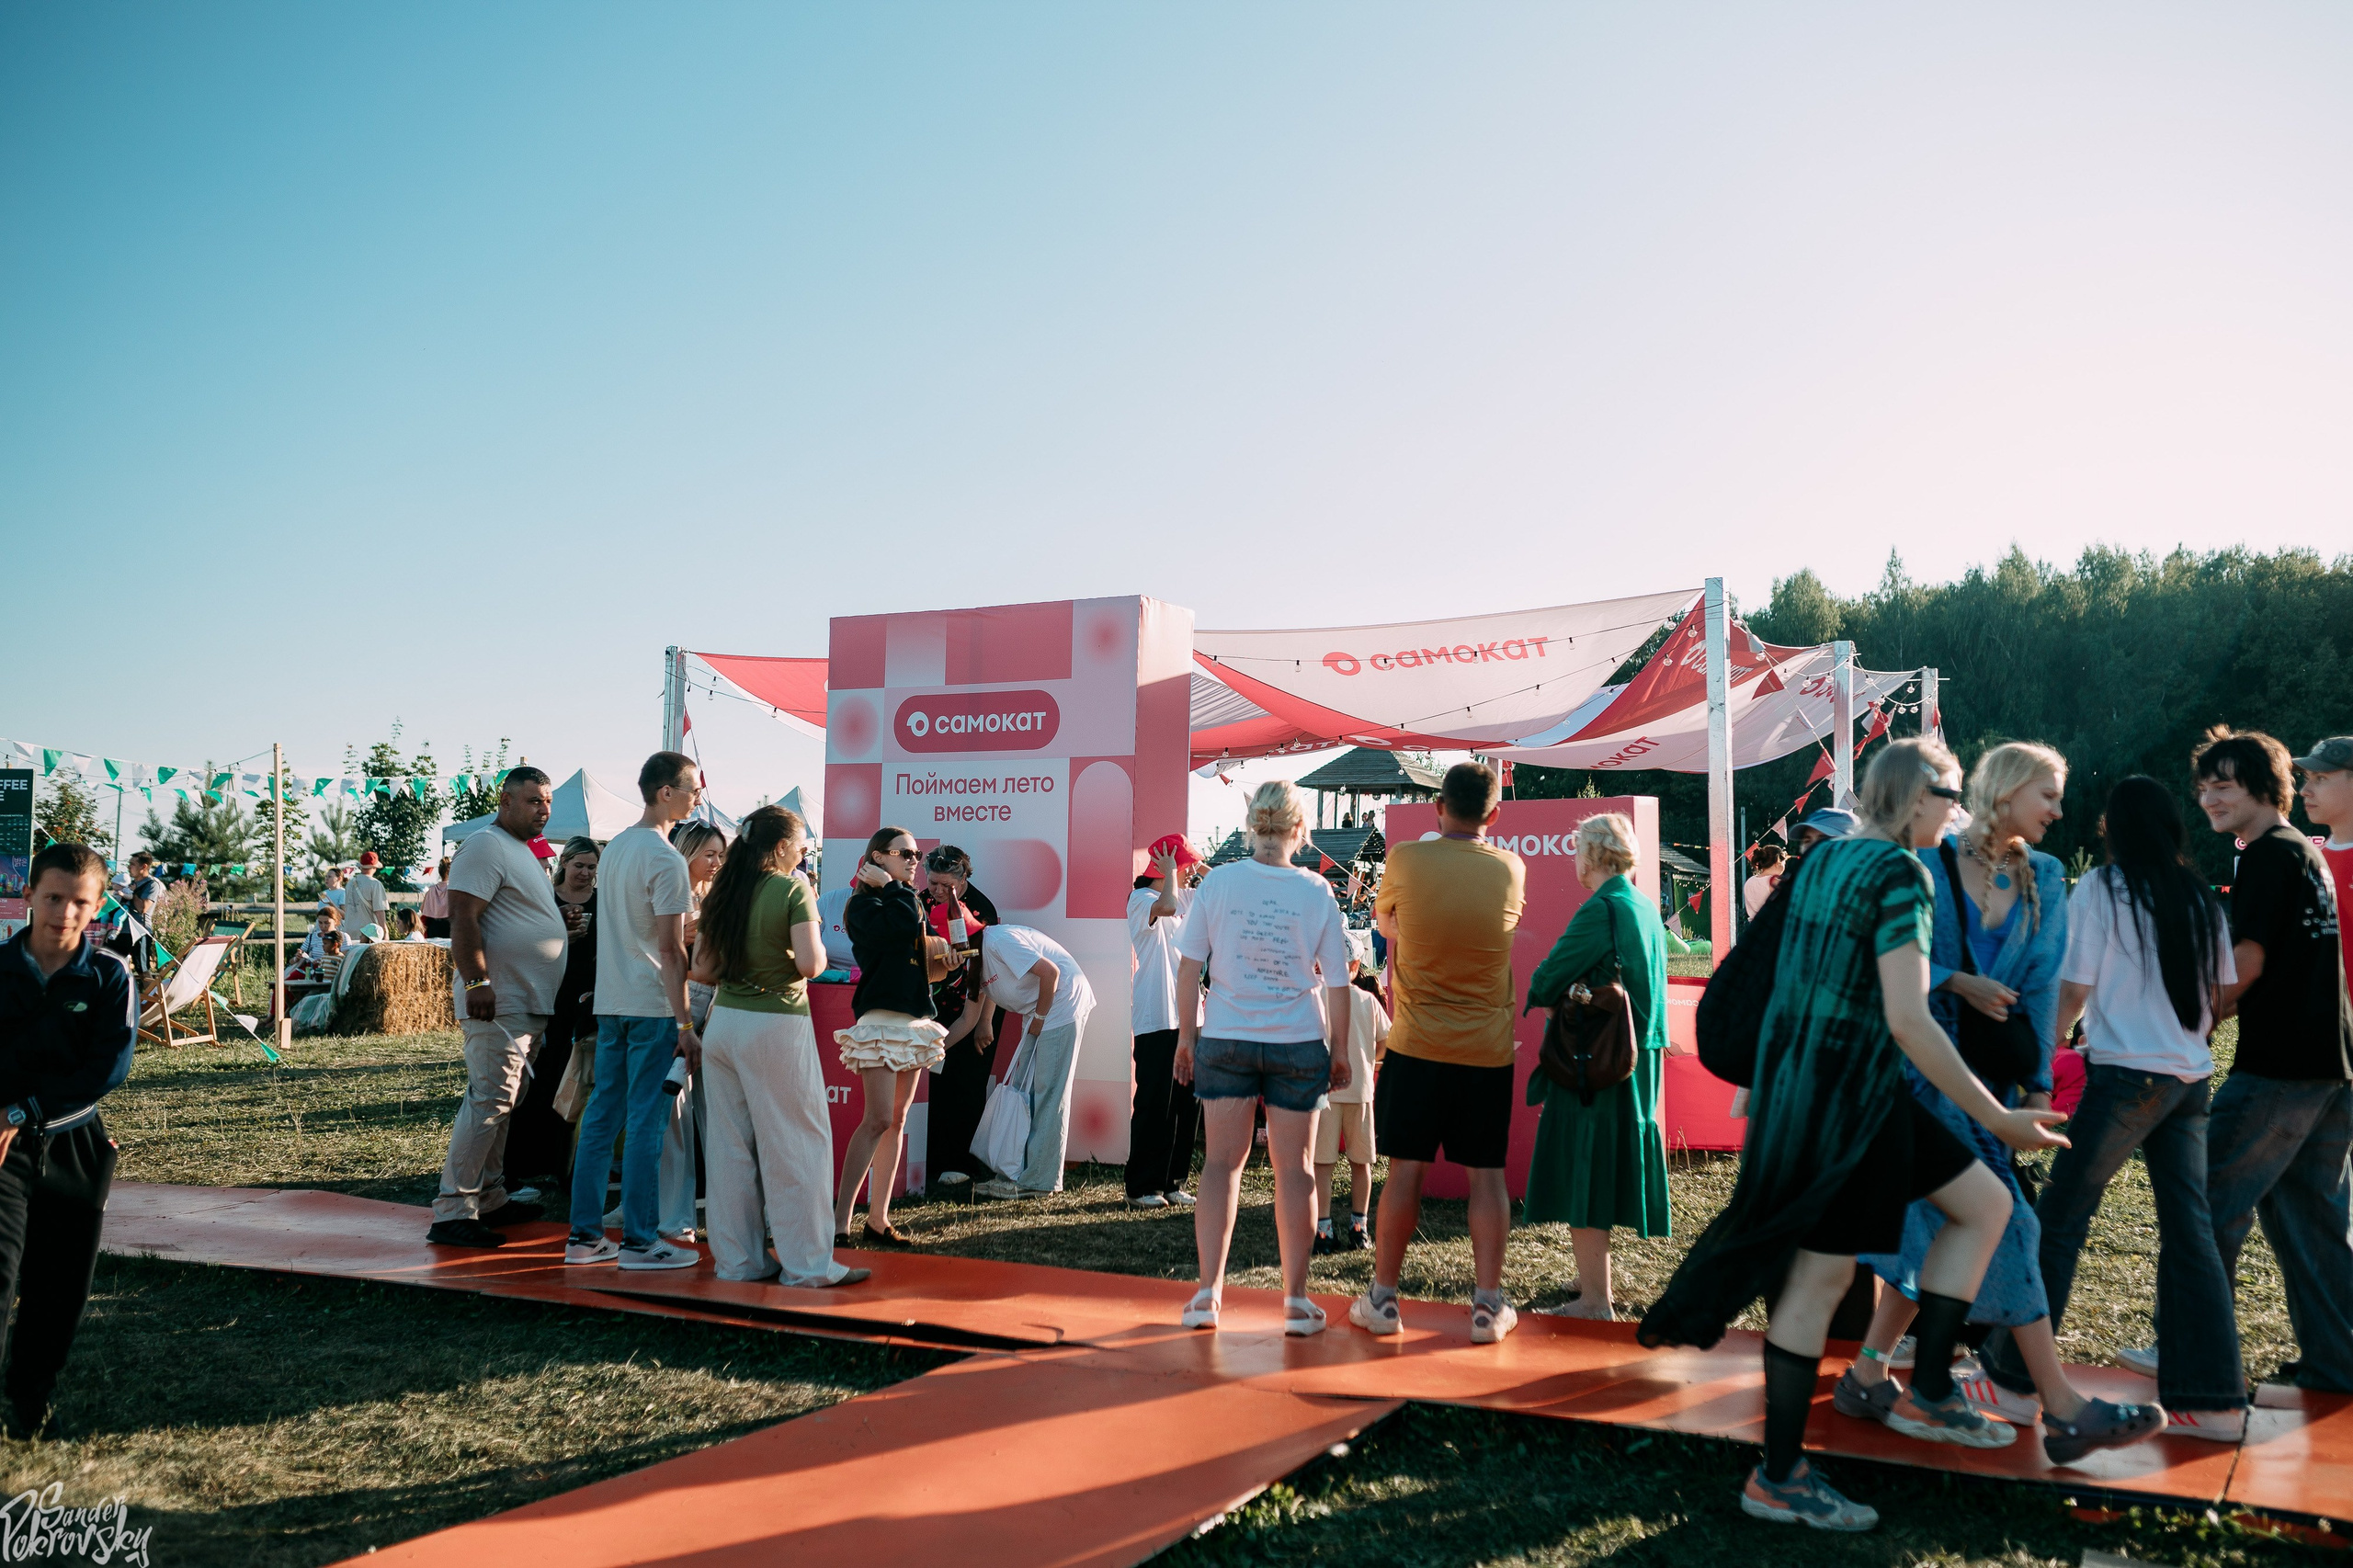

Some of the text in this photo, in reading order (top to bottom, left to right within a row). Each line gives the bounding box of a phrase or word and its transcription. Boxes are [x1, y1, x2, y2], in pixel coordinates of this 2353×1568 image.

[1370, 636, 1549, 671] самокат
[935, 711, 1047, 734] самокат
[895, 772, 1055, 795] Поймаем лето
[934, 805, 1012, 822] вместе
